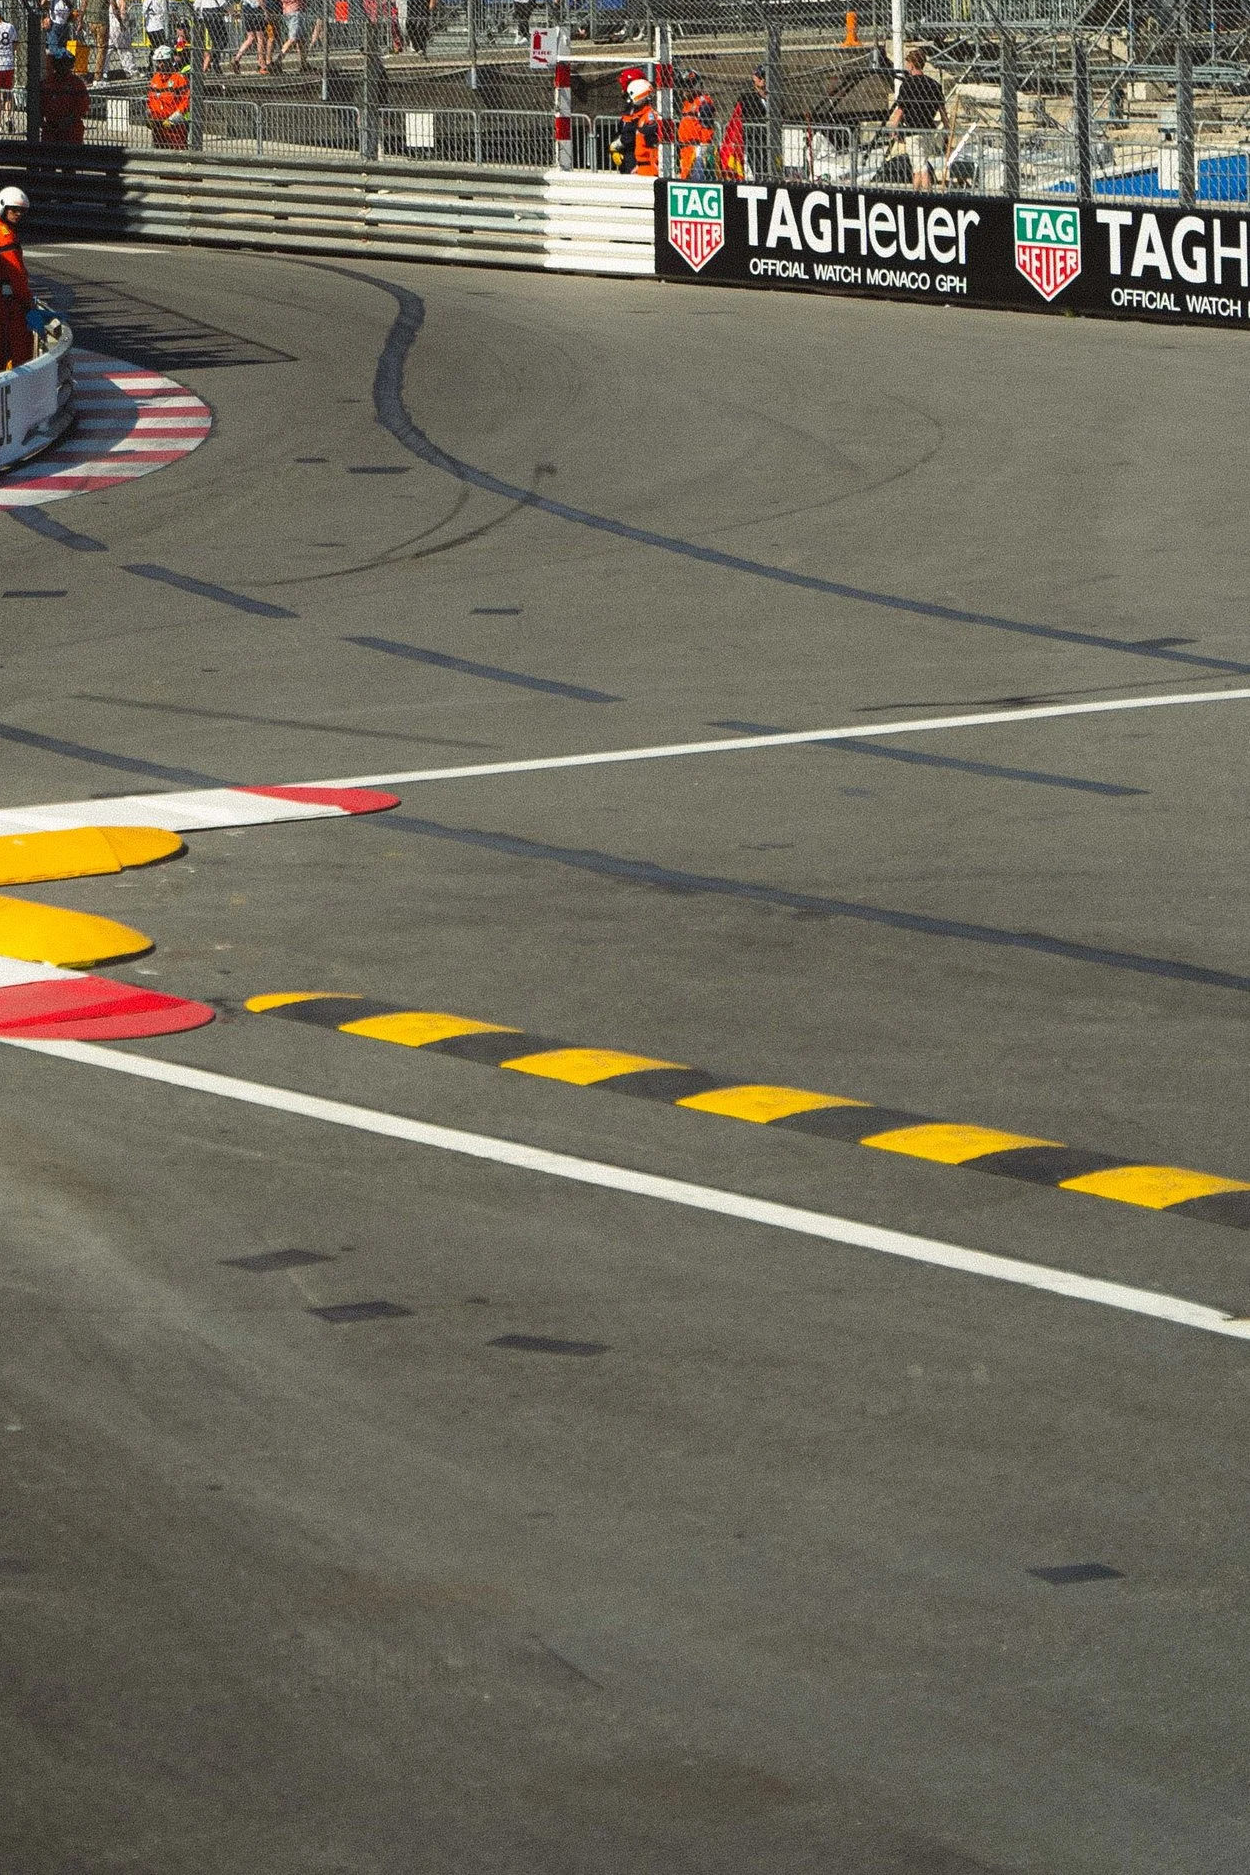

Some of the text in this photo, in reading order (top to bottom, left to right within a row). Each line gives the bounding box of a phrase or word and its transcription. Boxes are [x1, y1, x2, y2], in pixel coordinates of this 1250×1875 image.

[671, 187, 718, 218] TAG
[670, 220, 722, 266] HEUER
[1019, 210, 1074, 243] TAG
[1096, 209, 1250, 287] TAGH
[750, 257, 967, 294] OFFICIAL WATCH MONACO GPH
[1018, 246, 1078, 293] HEUER
[1111, 287, 1242, 318] OFFICIAL WATCH
